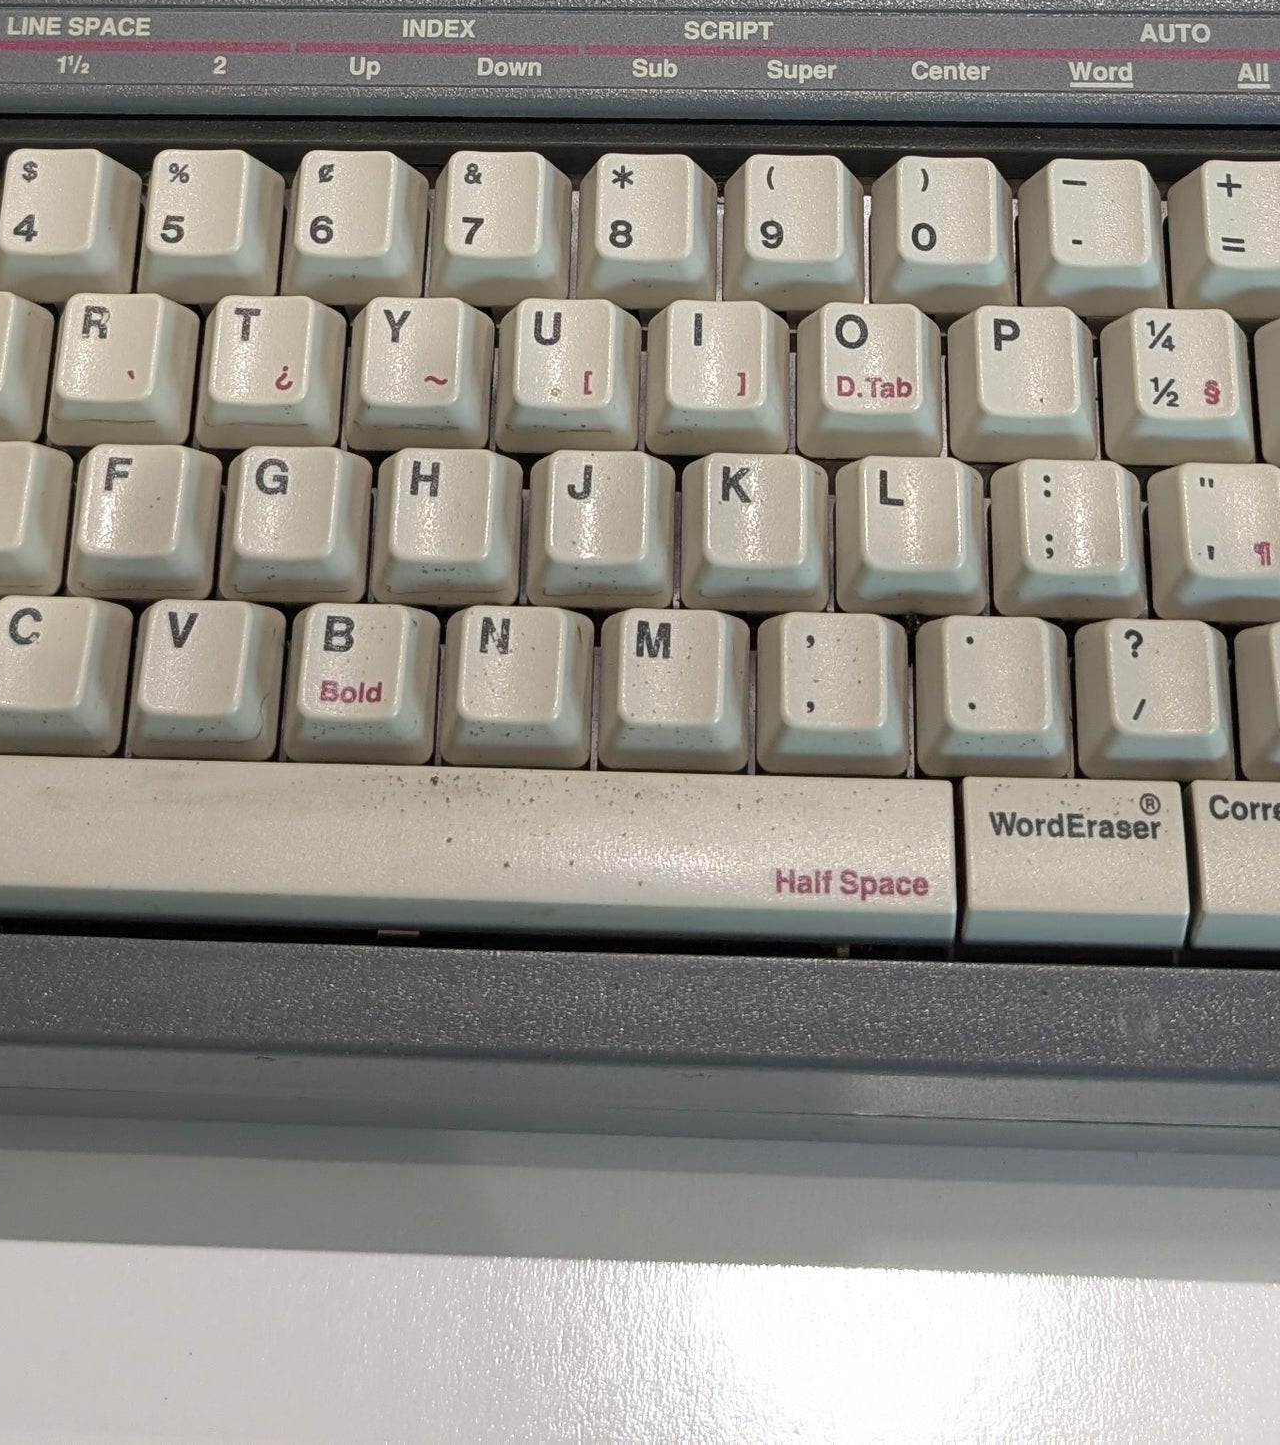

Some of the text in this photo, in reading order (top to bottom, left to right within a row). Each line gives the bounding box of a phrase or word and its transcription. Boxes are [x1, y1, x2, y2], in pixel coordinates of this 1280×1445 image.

[7, 17, 150, 36] LINE SPACE
[403, 19, 475, 37] INDEX
[684, 21, 773, 39] SCRIPT
[1141, 24, 1211, 42] AUTO
[213, 56, 226, 74] 2
[350, 57, 380, 80] Up
[478, 57, 541, 76] Down
[633, 59, 677, 77] Sub
[766, 59, 837, 87] Super
[912, 61, 990, 80] Center
[1069, 62, 1132, 81] Word
[1238, 63, 1269, 81] All
[22, 161, 37, 182] $
[169, 163, 189, 183] %
[464, 163, 481, 184] &
[767, 167, 774, 189] (
[921, 169, 929, 192] )
[1217, 174, 1241, 197] +
[13, 215, 37, 242] 4
[161, 215, 184, 243] 5
[310, 216, 333, 244] 6
[462, 217, 484, 244] 7
[609, 220, 632, 248] 8
[760, 220, 783, 249] 9
[912, 223, 936, 251] 0
[1222, 238, 1245, 252] =
[82, 306, 108, 339] R
[235, 308, 260, 341] T
[384, 310, 410, 343] Y
[534, 311, 561, 345] U
[694, 313, 702, 346] I
[835, 314, 868, 349] O
[994, 319, 1020, 351] P
[275, 366, 293, 391] ¿
[584, 371, 592, 394] [
[737, 372, 746, 395] ]
[836, 375, 912, 399] D.Tab
[1204, 380, 1220, 405] §
[104, 458, 132, 491] F
[256, 459, 288, 495] G
[410, 461, 440, 497] H
[568, 465, 592, 500] J
[722, 466, 751, 503] K
[880, 470, 904, 506] L
[1044, 475, 1051, 497] :
[1046, 534, 1054, 558] ;
[9, 608, 42, 645] C
[168, 612, 198, 648] V
[324, 616, 354, 652] B
[480, 617, 510, 654] N
[636, 621, 671, 659] M
[1125, 630, 1143, 657] ?
[320, 681, 382, 704] Bold
[1133, 699, 1146, 720] /
[990, 812, 1162, 840] WordEraser
[776, 871, 929, 900] Half Space
